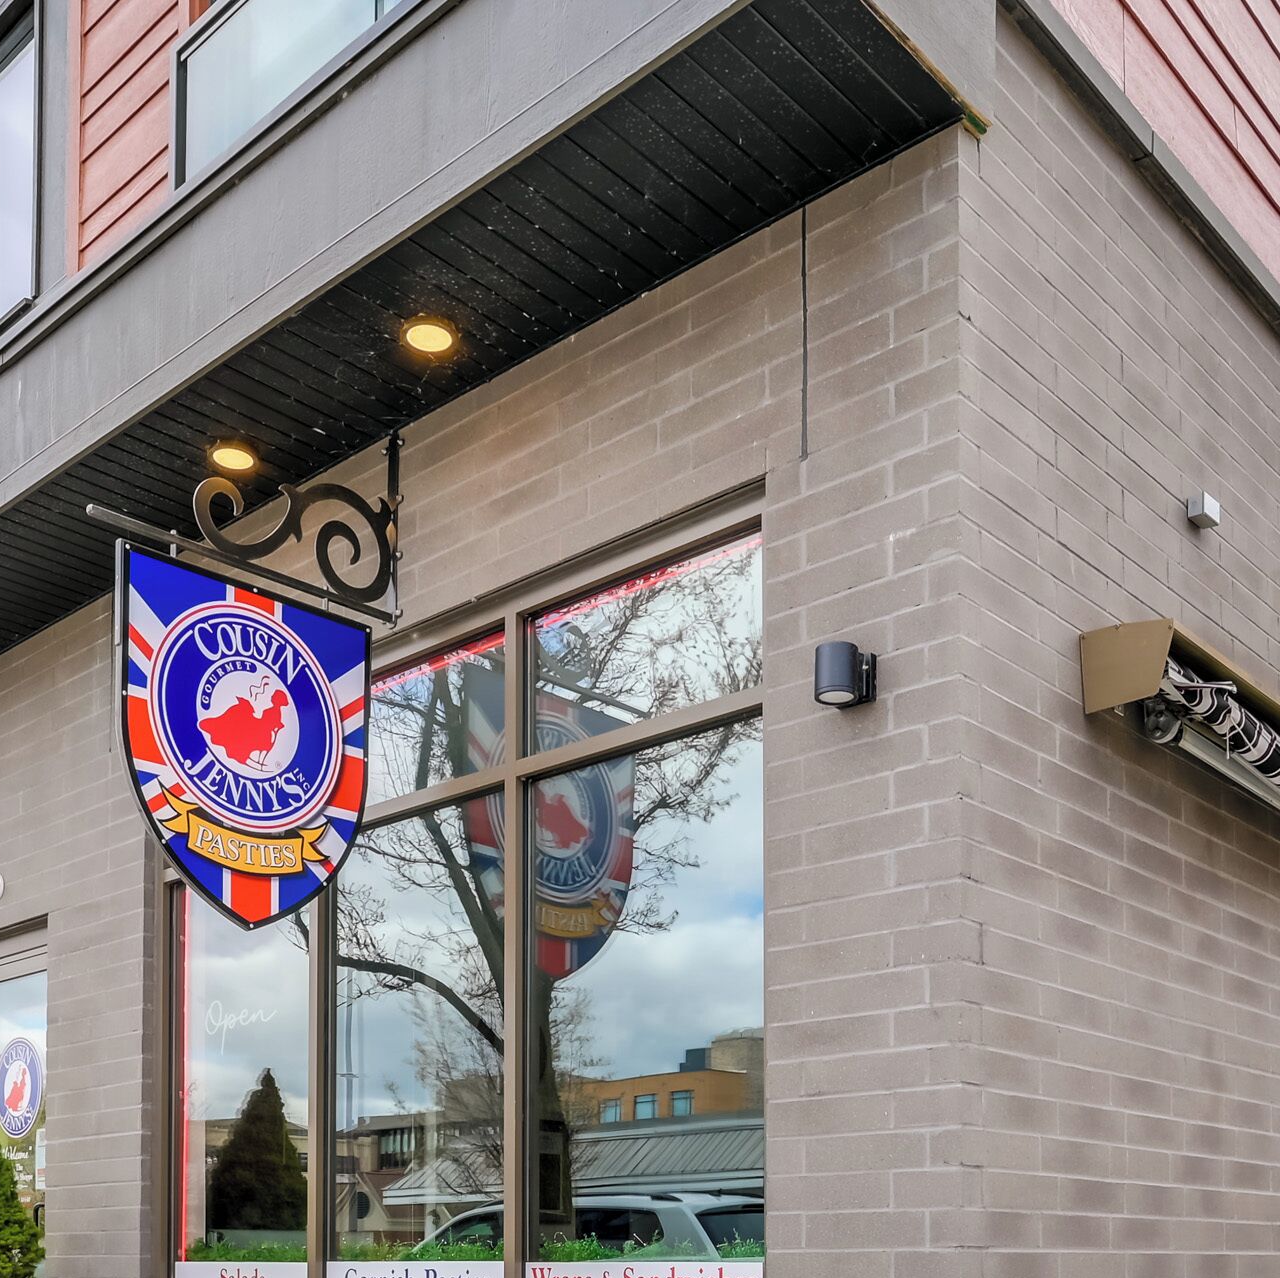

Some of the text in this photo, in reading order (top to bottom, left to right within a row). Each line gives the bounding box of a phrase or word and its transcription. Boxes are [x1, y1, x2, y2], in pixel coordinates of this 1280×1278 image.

[194, 622, 307, 685] COUSIN
[201, 661, 252, 704] GOURMET
[183, 747, 306, 812] JENNY'S
[293, 767, 311, 791] INC
[195, 824, 297, 868] PASTIES
[205, 1000, 278, 1056] Open
[3, 1045, 33, 1069] COUSIN
